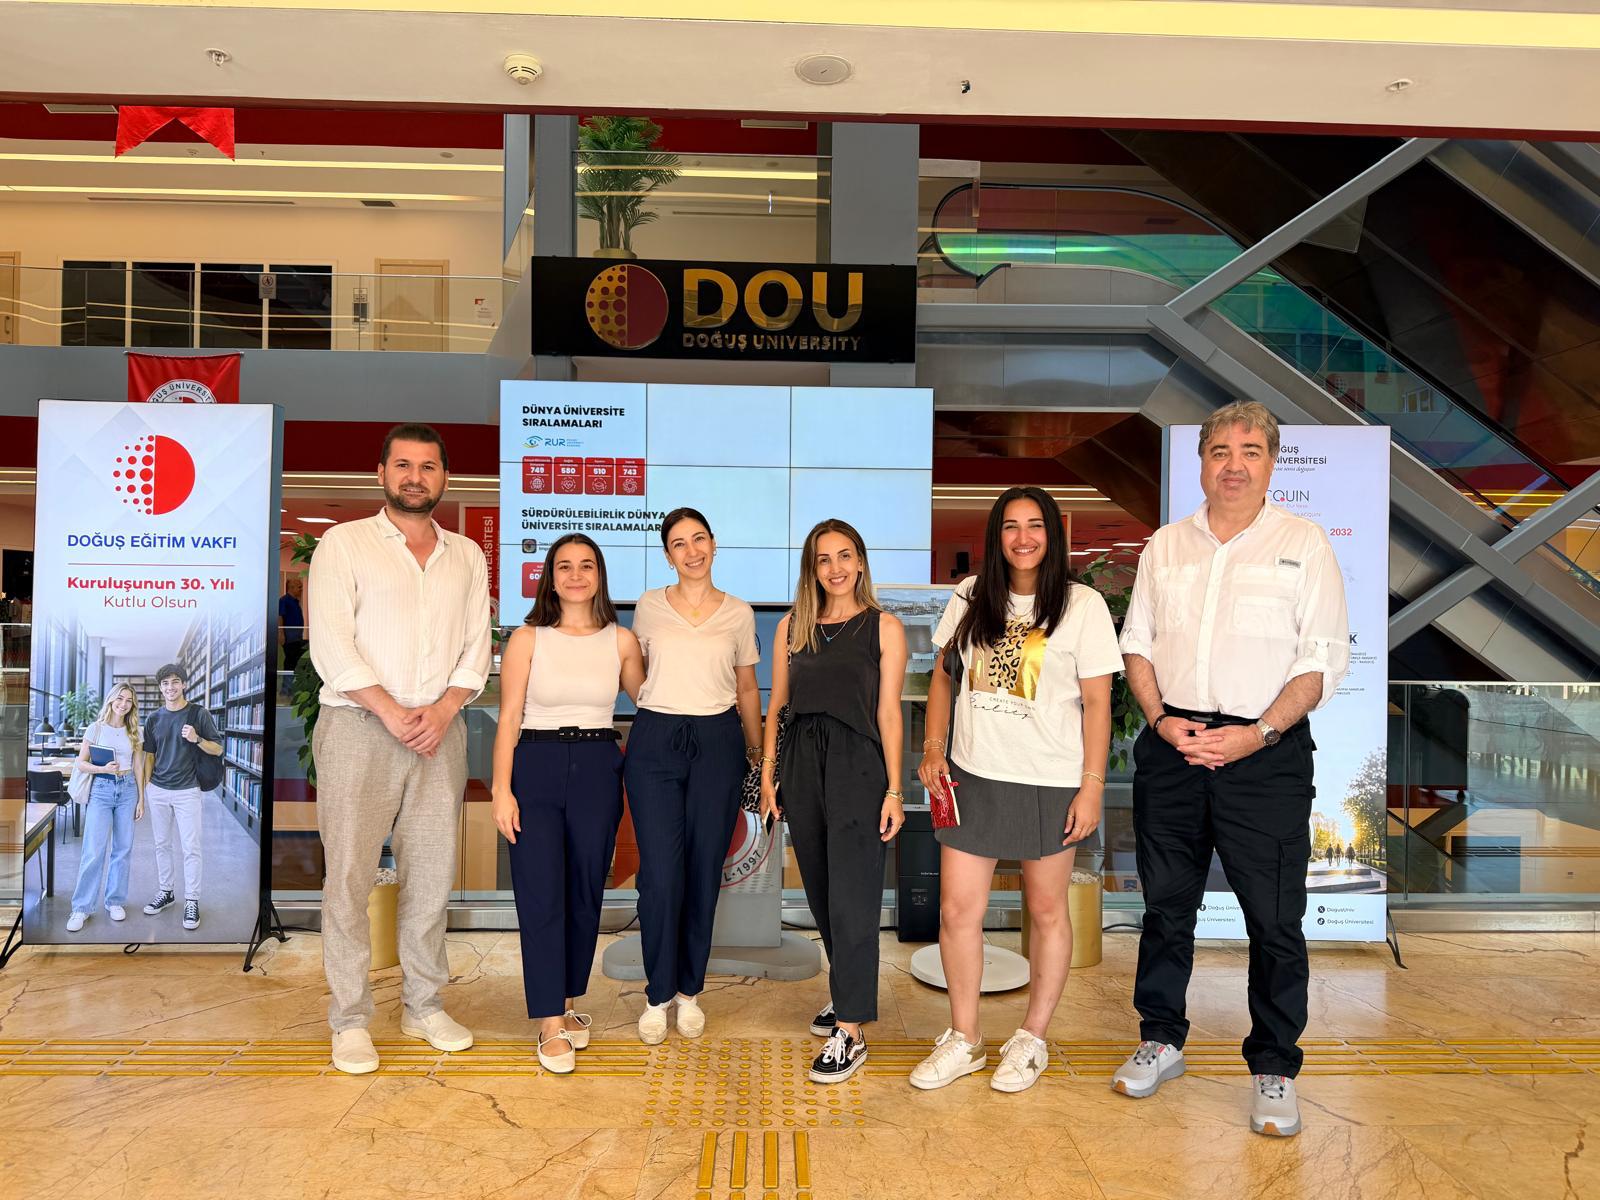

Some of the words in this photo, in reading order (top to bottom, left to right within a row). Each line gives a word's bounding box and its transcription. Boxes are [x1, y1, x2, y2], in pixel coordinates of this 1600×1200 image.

[683, 268, 863, 333] DOU
[682, 331, 748, 352] DOĞUŞ
[753, 334, 861, 351] UNIVERSITY
[169, 382, 213, 403] ÜNİVERSİT
[522, 404, 561, 415] DÜNYA
[563, 404, 625, 416] ÜNİVERSİTE
[522, 418, 603, 428] SIRALAMALARI
[544, 438, 566, 447] RUR
[1280, 445, 1299, 454] ĞUŞ
[1275, 456, 1327, 465] NİVERSİTESİ
[1268, 489, 1310, 502] QUIN
[521, 507, 625, 519] SÜRDÜRÜLEBİLİRLİK
[627, 509, 665, 519] DÜNYA
[521, 519, 584, 530] ÜNİVERSİTE
[585, 522, 662, 532] SIRALAMALAR
[1329, 528, 1353, 536] 2032
[67, 532, 126, 550] DOĞUŞ
[130, 533, 186, 549] EĞİTİM
[191, 536, 237, 549] VAKFI
[67, 576, 176, 592] Kuruluşunun
[180, 578, 205, 590] 30.
[210, 578, 235, 590] Yılı
[104, 595, 146, 608] Kutlu
[151, 595, 198, 608] Olsun
